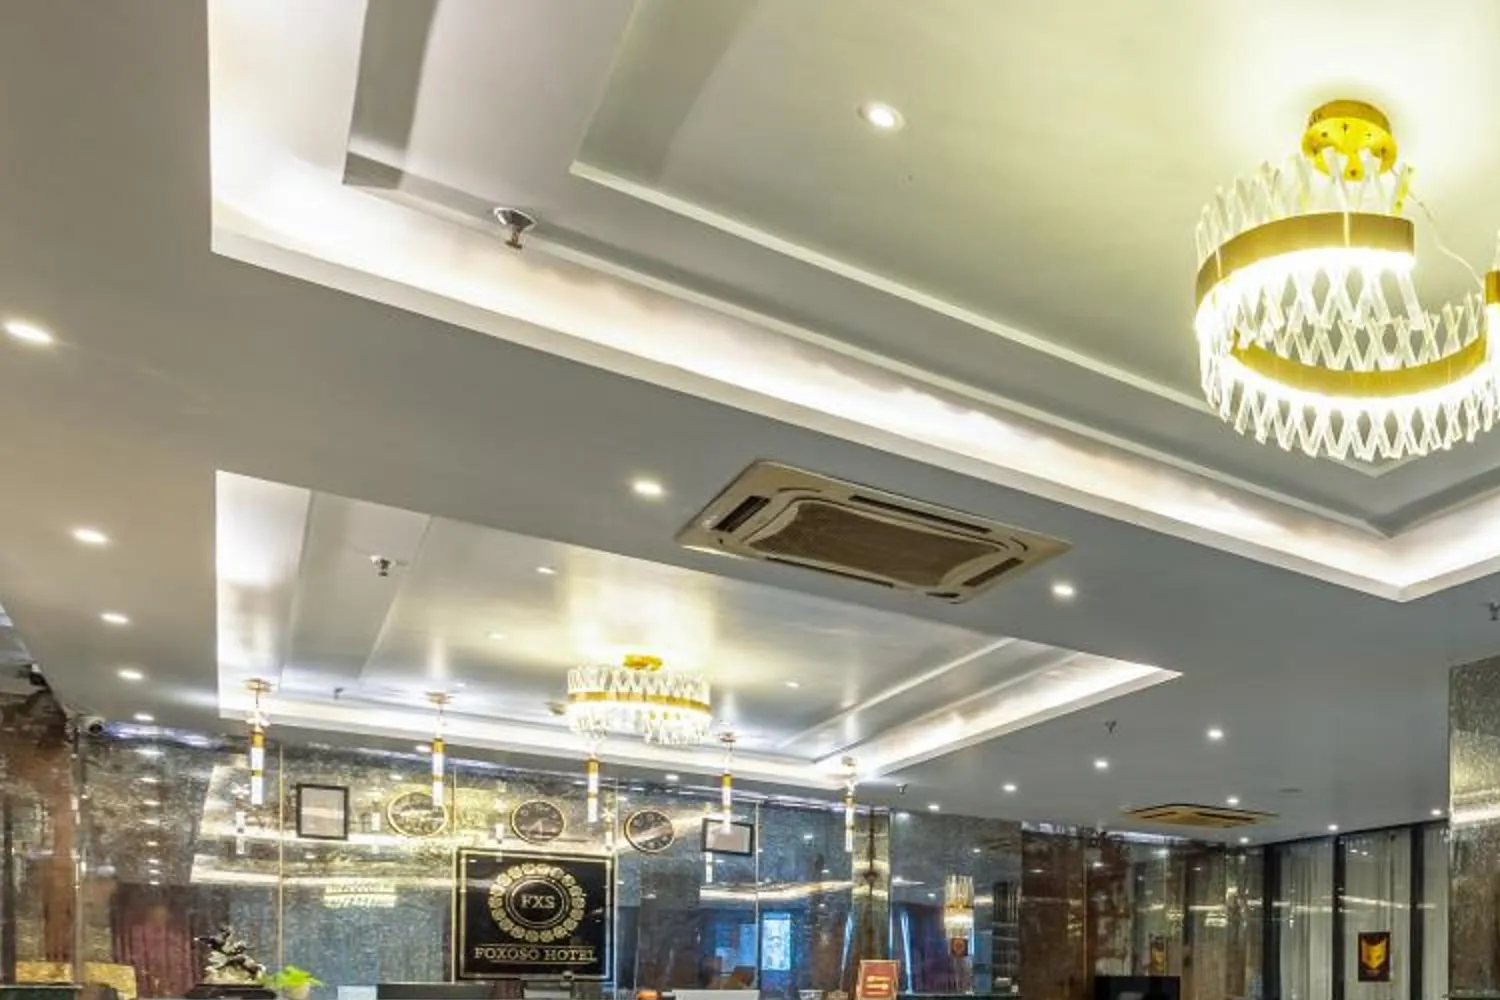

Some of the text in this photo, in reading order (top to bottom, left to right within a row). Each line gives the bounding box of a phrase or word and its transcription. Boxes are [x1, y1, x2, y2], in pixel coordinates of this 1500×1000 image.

[521, 895, 556, 910] FXS
[474, 947, 597, 962] FOXOSO HOTEL
